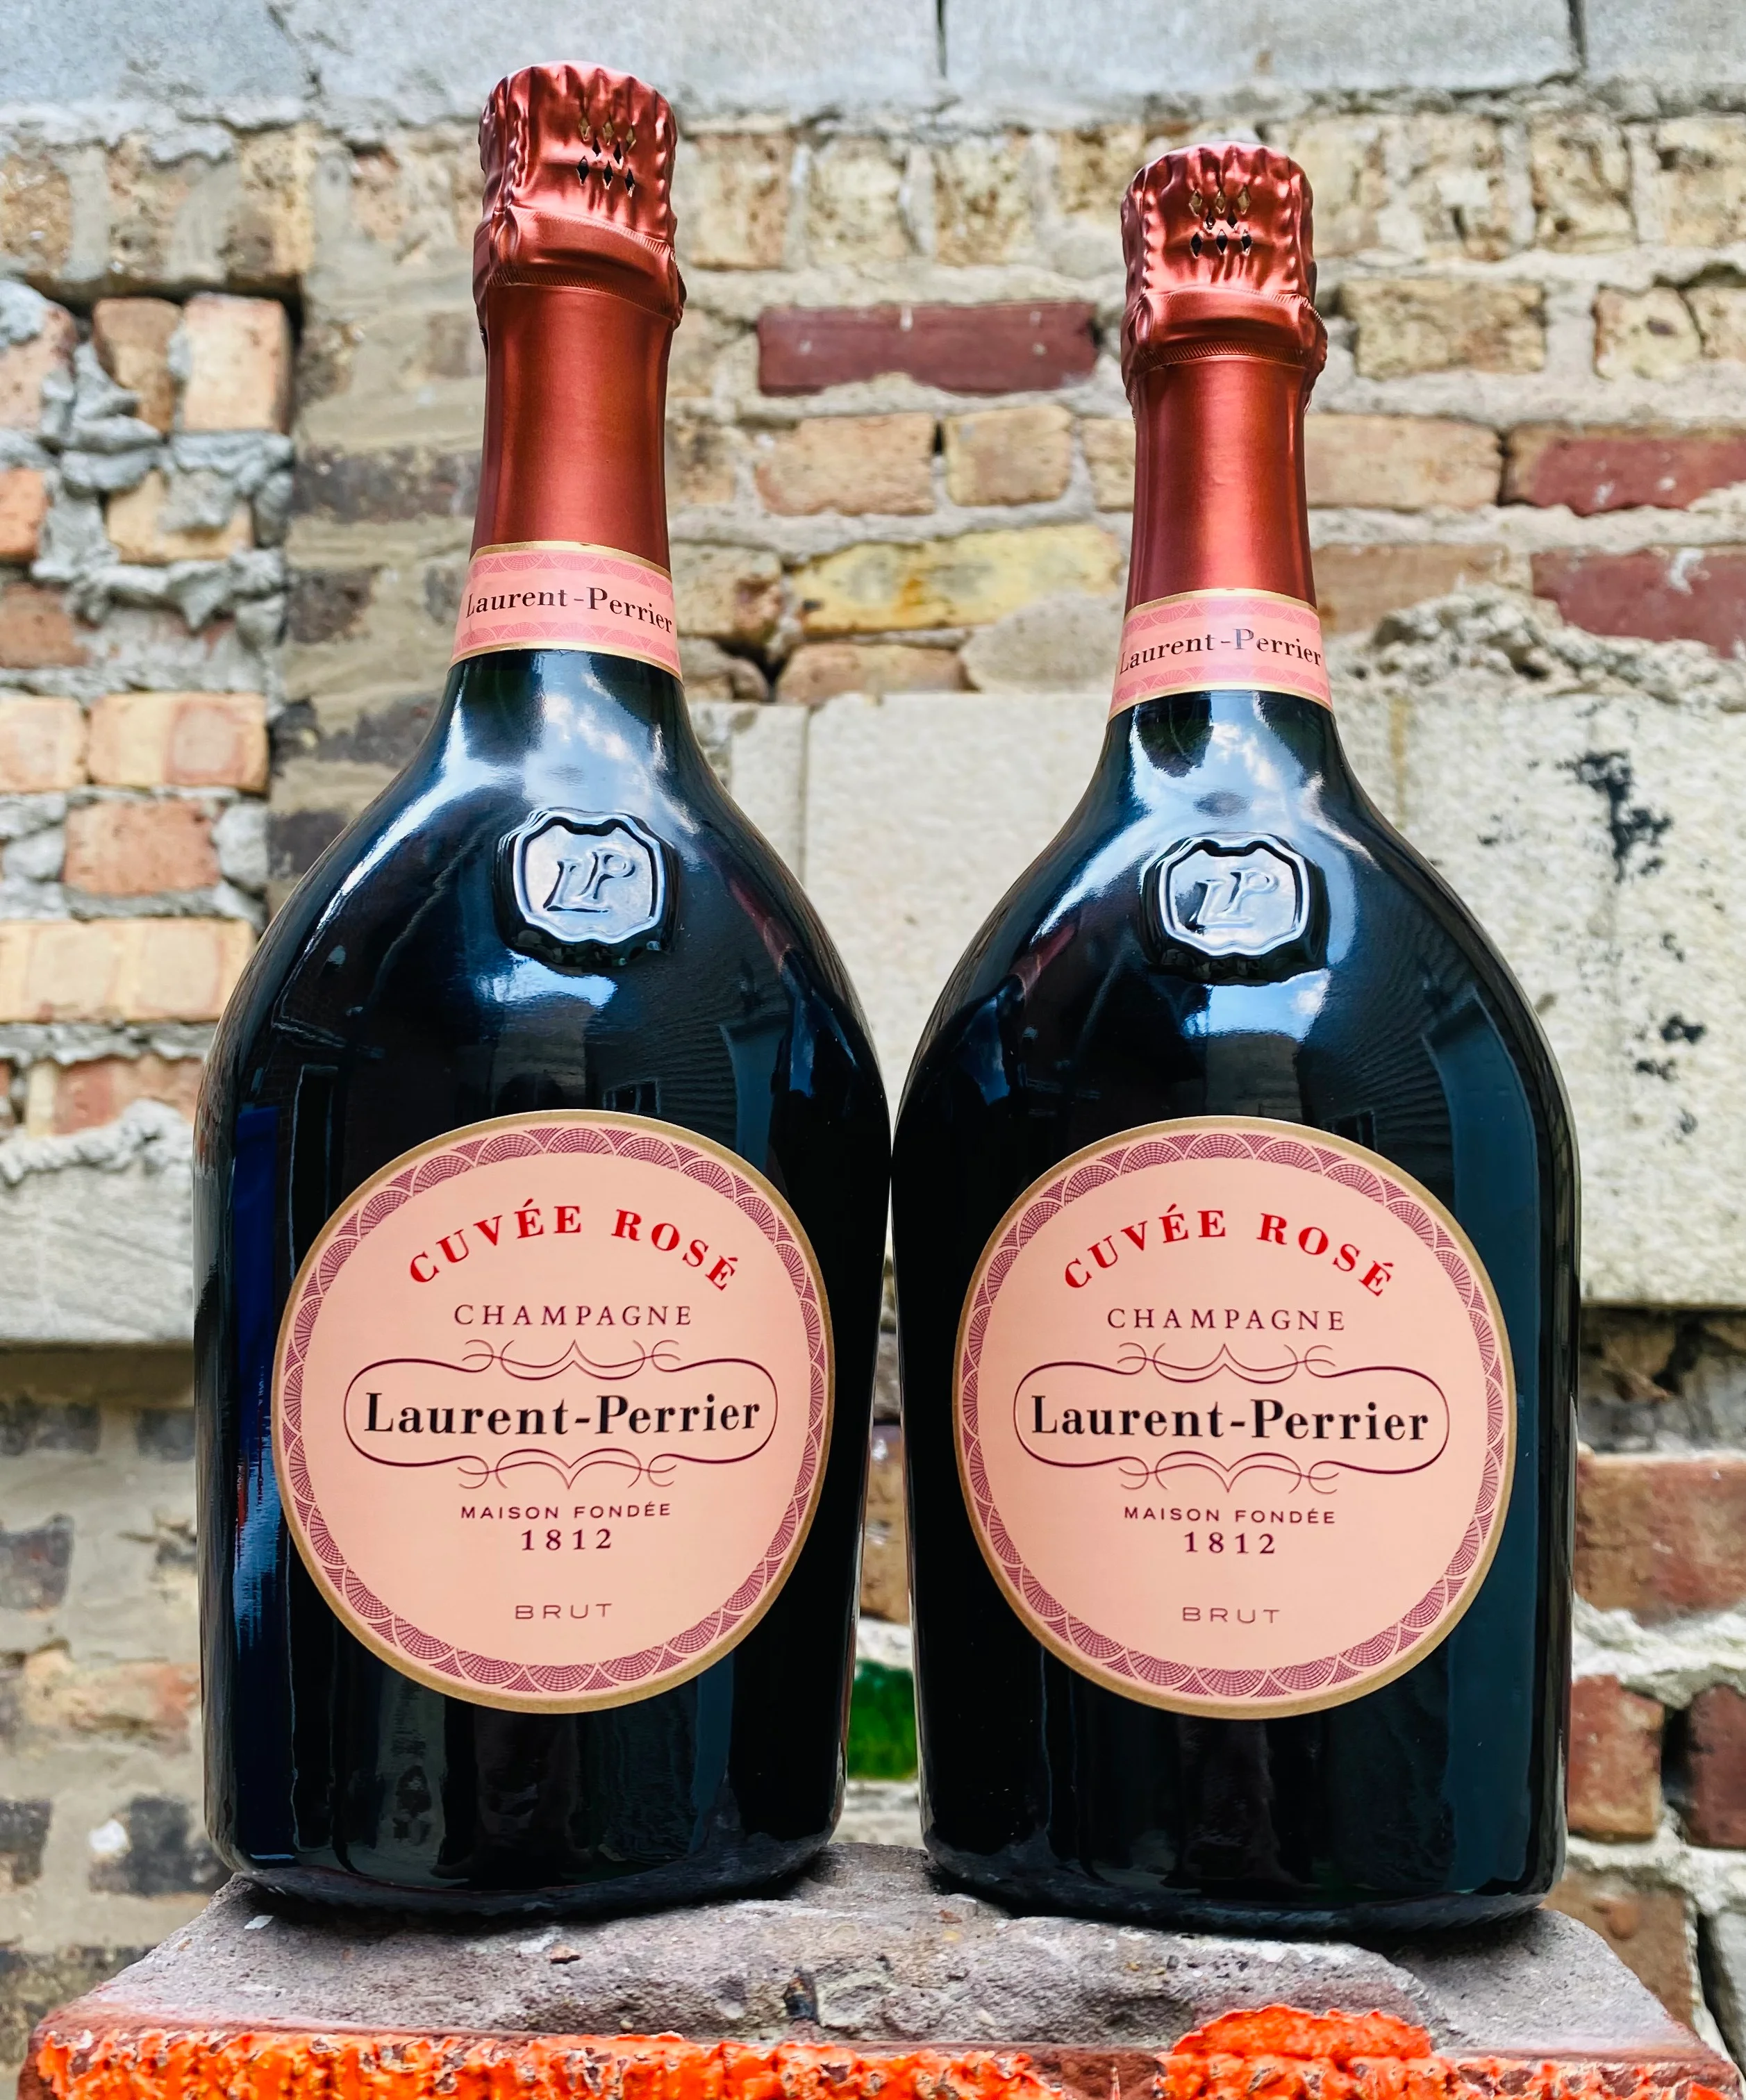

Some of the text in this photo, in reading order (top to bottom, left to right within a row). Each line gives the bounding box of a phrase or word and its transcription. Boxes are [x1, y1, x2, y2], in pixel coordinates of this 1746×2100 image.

[466, 586, 673, 633] Laurent-Perrier
[1119, 628, 1322, 675] Laurent-Perrier
[542, 848, 637, 914] LP
[1183, 867, 1281, 929] LP
[409, 1198, 739, 1292] CUVÉE ROSÉ
[1063, 1203, 1393, 1297] CUVÉE ROSÉ
[454, 1303, 692, 1326] CHAMPAGNE
[1107, 1308, 1345, 1331] CHAMPAGNE
[364, 1391, 760, 1436] Laurent-Perrier
[1031, 1394, 1429, 1441] Laurent-Perrier
[460, 1501, 671, 1519] MAISON FONDÉE
[1124, 1506, 1336, 1524] MAISON FONDÉE
[522, 1528, 612, 1551] 1812
[1183, 1531, 1277, 1554] 1812
[515, 1603, 613, 1620] BRUT
[1182, 1606, 1280, 1624] BRUT
